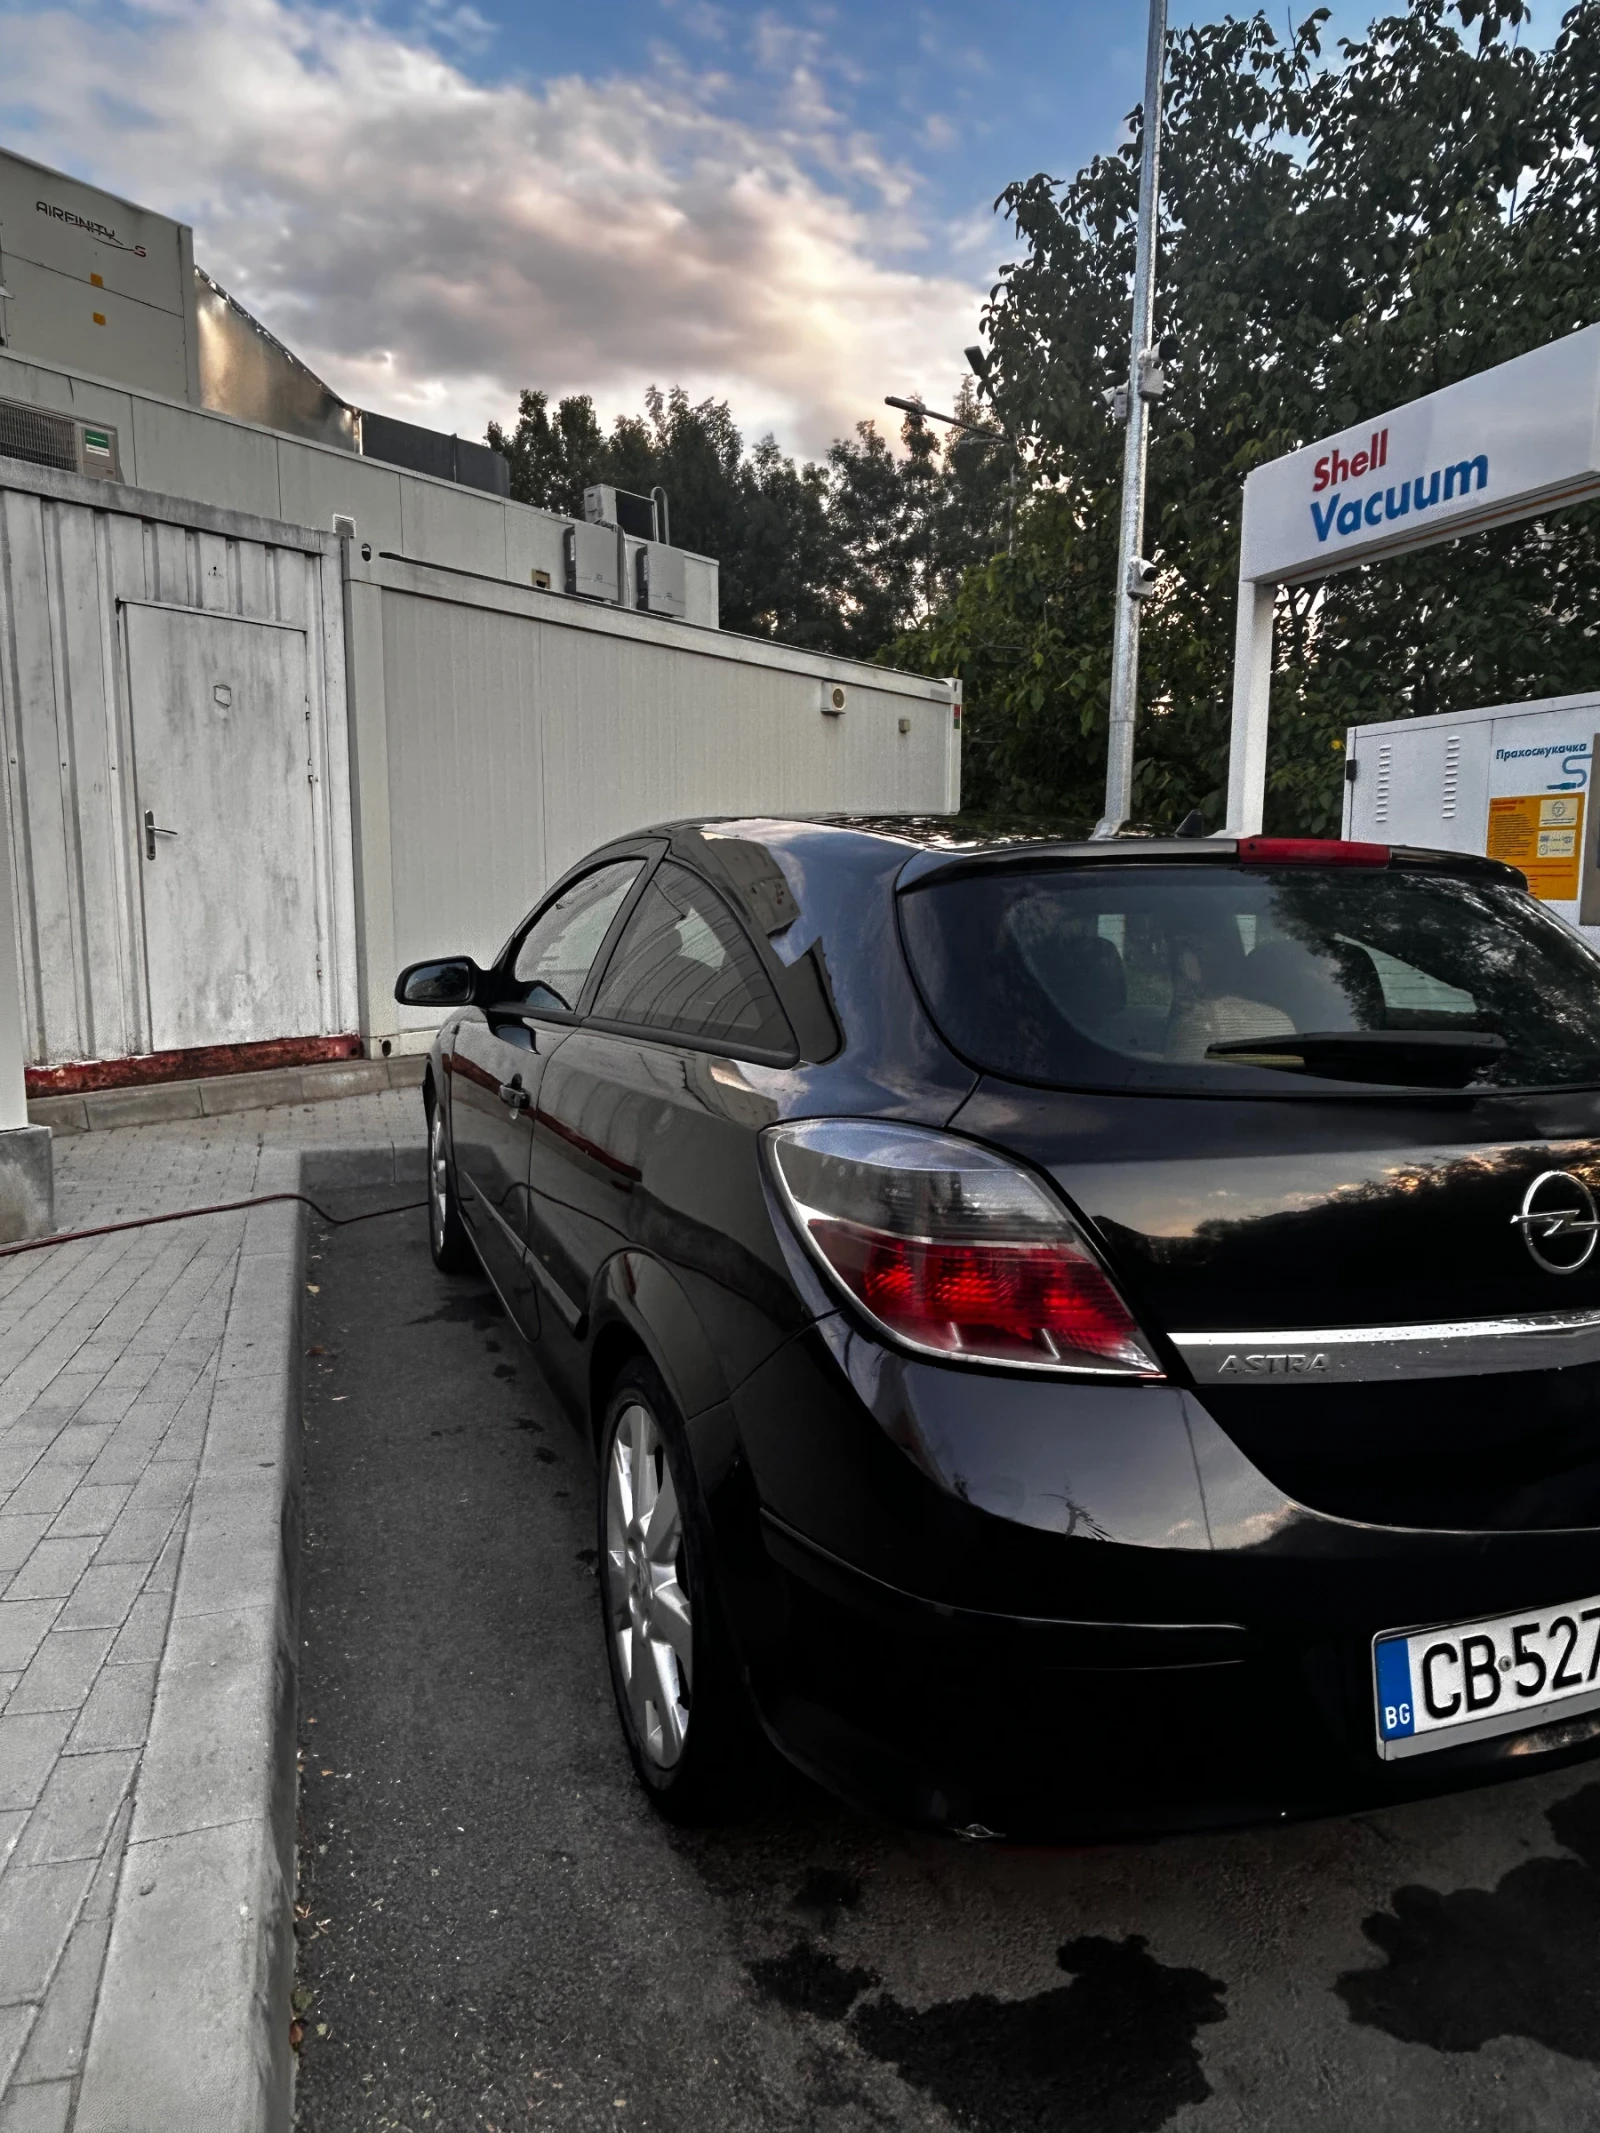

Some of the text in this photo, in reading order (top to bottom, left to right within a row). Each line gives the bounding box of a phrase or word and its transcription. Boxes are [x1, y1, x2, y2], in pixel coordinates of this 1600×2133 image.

[36, 201, 115, 239] AIRFINITY
[1312, 428, 1388, 492] Shell
[1310, 454, 1488, 543] Vacuum
[1495, 743, 1587, 762] Прахосмукачка
[1217, 1354, 1327, 1374] ASTRA
[1422, 1634, 1500, 1720] CB
[1384, 1703, 1411, 1730] BG
